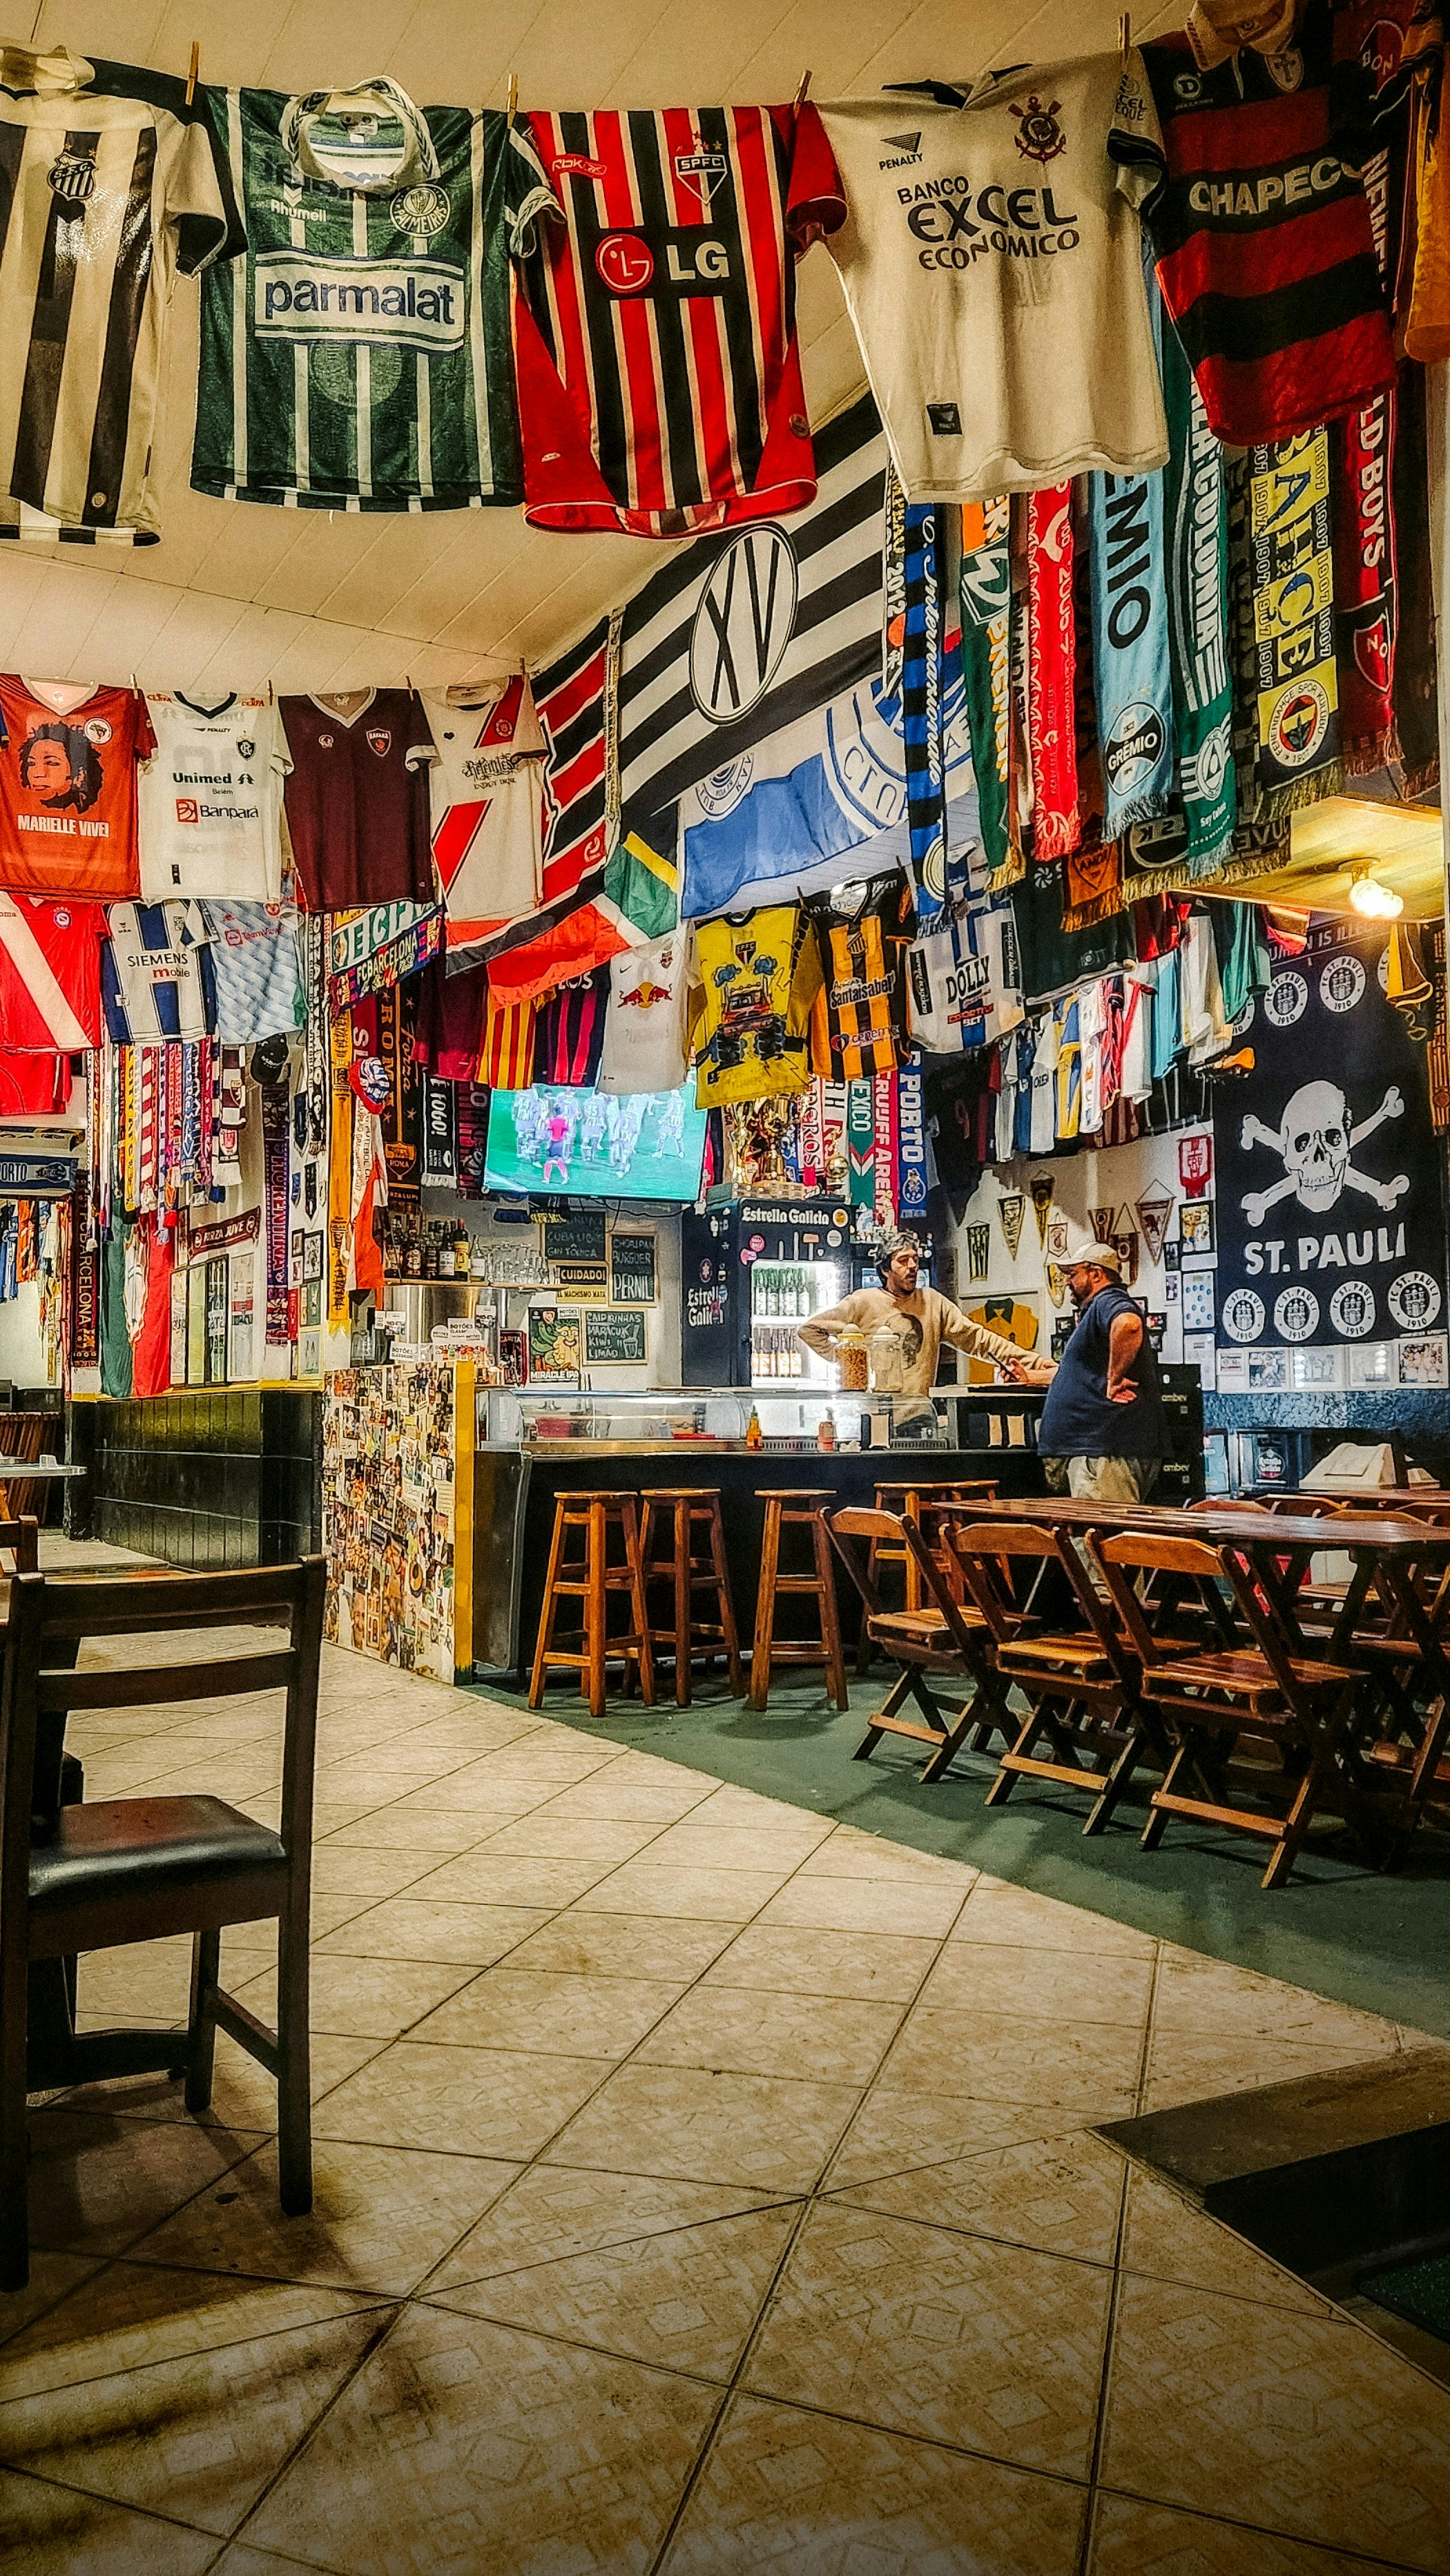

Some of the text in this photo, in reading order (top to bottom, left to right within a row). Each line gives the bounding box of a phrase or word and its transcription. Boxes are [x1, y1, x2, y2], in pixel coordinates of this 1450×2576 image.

[54, 162, 91, 179] S.F.C.
[681, 157, 722, 171] SPFC
[879, 153, 923, 171] PENALTY
[897, 175, 969, 206] BANCO
[271, 199, 327, 223] Rhumell
[394, 206, 447, 233] PALMEIRAS
[908, 186, 1078, 243] EXCEL
[666, 242, 730, 280] LG
[919, 229, 1080, 271] ECONOMICO
[265, 277, 456, 327] parmalat
[1314, 443, 1328, 491] 1907
[1254, 479, 1269, 529] 1907
[1360, 454, 1385, 568] BOYS
[1315, 501, 1328, 549] 1907
[1255, 539, 1270, 583] 1907
[886, 562, 906, 617] 2012
[1317, 554, 1330, 603] 1907
[704, 535, 781, 710] XV
[1257, 590, 1271, 637] 1907
[1319, 610, 1331, 657] 1907
[1259, 643, 1273, 688] 1907
[1108, 732, 1158, 771] GRÊMIO
[173, 773, 232, 784] Unimed
[200, 806, 259, 820] Banpará
[18, 814, 109, 837] MARIELLE VIVE!
[128, 953, 188, 967] SIEMENS
[1341, 958, 1365, 978] PAULI
[945, 955, 990, 1005] DOLLY
[1284, 973, 1307, 994] PAULI
[1334, 1000, 1353, 1010] 1910
[1277, 1014, 1296, 1025] 1910
[430, 1094, 447, 1136] FOGO!
[899, 1074, 924, 1163] PORTO
[0, 1163, 28, 1182] ORTO
[742, 1207, 830, 1226] Estrella Galicia
[225, 1221, 245, 1238] JUVE
[1245, 1222, 1406, 1275] ST. PAULI
[561, 1269, 606, 1281] CUIDADO!
[613, 1274, 654, 1300] PERNIL
[1413, 1273, 1439, 1297] PAULI
[1243, 1291, 1263, 1314] PAULI
[1296, 1288, 1317, 1311] PAULI
[1353, 1284, 1373, 1307] PAULI
[1345, 1326, 1365, 1335] 1910
[1406, 1317, 1428, 1327] 1910
[1236, 1331, 1253, 1339] 1910
[1288, 1330, 1306, 1339] 1910
[530, 1370, 579, 1379] MIRACLE IPA
